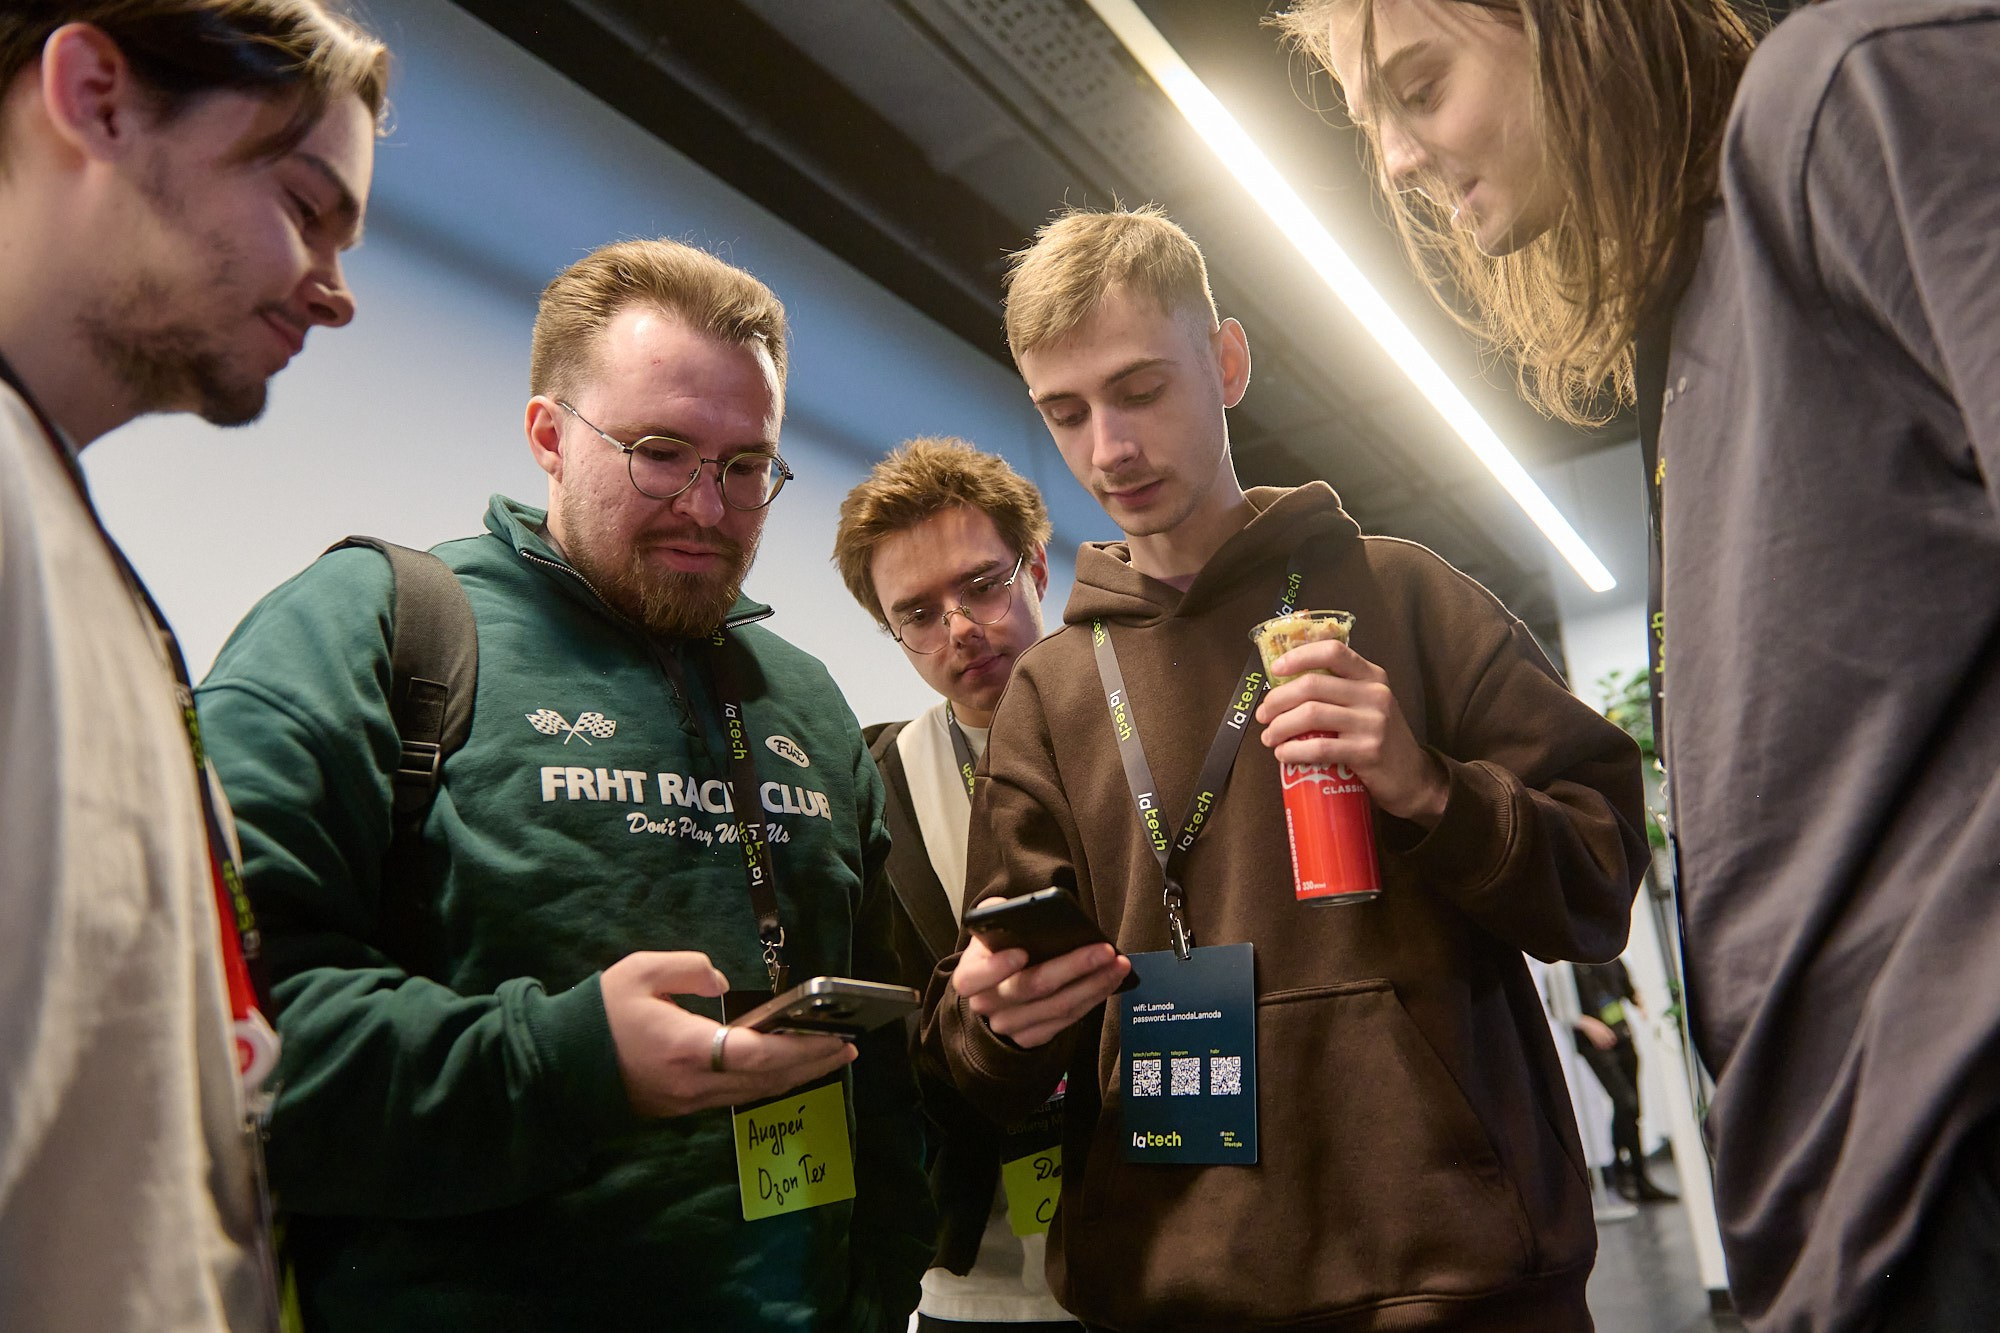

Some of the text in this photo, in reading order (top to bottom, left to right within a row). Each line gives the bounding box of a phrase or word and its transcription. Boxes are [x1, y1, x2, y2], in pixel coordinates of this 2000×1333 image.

[1276, 573, 1302, 618] latech
[1110, 689, 1132, 741] latech
[1227, 671, 1262, 729] latech
[725, 703, 747, 760] latech
[541, 766, 832, 821] FRHT RACI CLUB
[1322, 784, 1364, 795] CLASSIC
[626, 811, 676, 836] Don't
[678, 816, 714, 847] Play
[766, 823, 791, 844] Us
[1137, 792, 1168, 851] latech
[1177, 791, 1214, 851] latech
[1133, 1002, 1175, 1013] wifi: Lamoda
[1133, 1010, 1222, 1025] password: LamodaLamoda
[1132, 1131, 1182, 1148] latech
